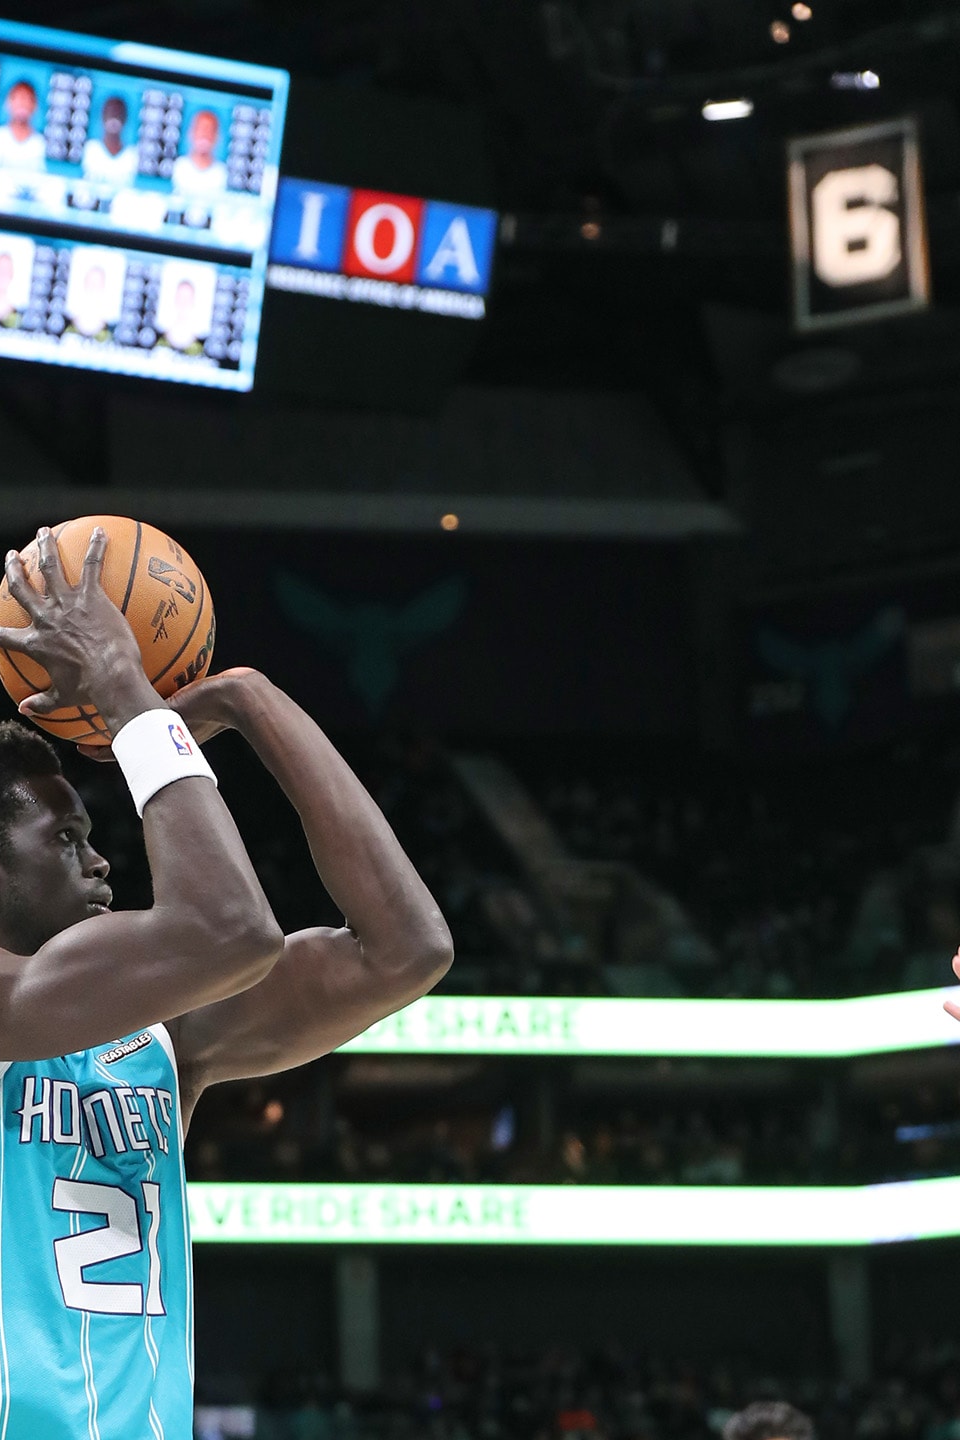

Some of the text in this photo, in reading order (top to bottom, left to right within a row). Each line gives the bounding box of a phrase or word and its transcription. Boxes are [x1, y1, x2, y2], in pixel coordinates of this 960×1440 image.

[295, 190, 481, 286] IOA
[811, 162, 902, 289] 6
[98, 1031, 153, 1064] FEASTABLES
[11, 1076, 173, 1159] HONETS
[51, 1176, 168, 1317] 21
